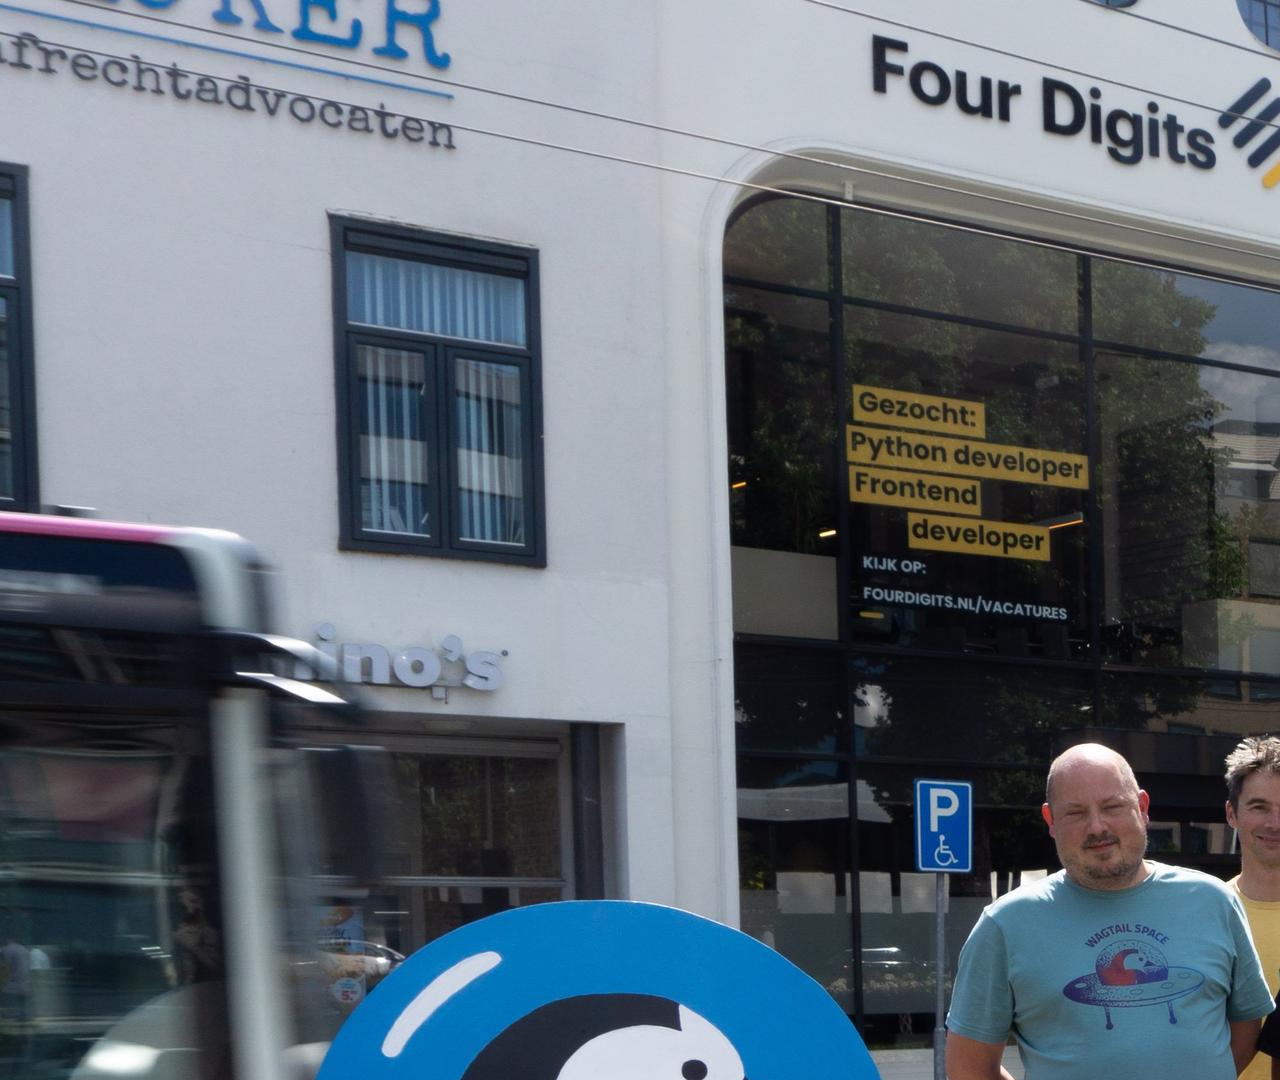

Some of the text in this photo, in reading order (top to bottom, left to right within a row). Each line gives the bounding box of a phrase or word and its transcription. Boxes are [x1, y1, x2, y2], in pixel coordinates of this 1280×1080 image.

[0, 33, 456, 151] frechtadvocaten
[872, 33, 1217, 170] Four Digits
[858, 391, 976, 427] Gezocht:
[850, 431, 1083, 482] Python developer
[855, 472, 977, 505] Frontend
[911, 519, 1044, 554] developer
[862, 556, 927, 574] KIJK OP:
[863, 587, 1068, 620] FOURDIGITS.NL/VACATURES
[294, 622, 504, 692] ino's
[929, 787, 960, 832] P
[1085, 923, 1170, 948] WAGTAIL SPACE
